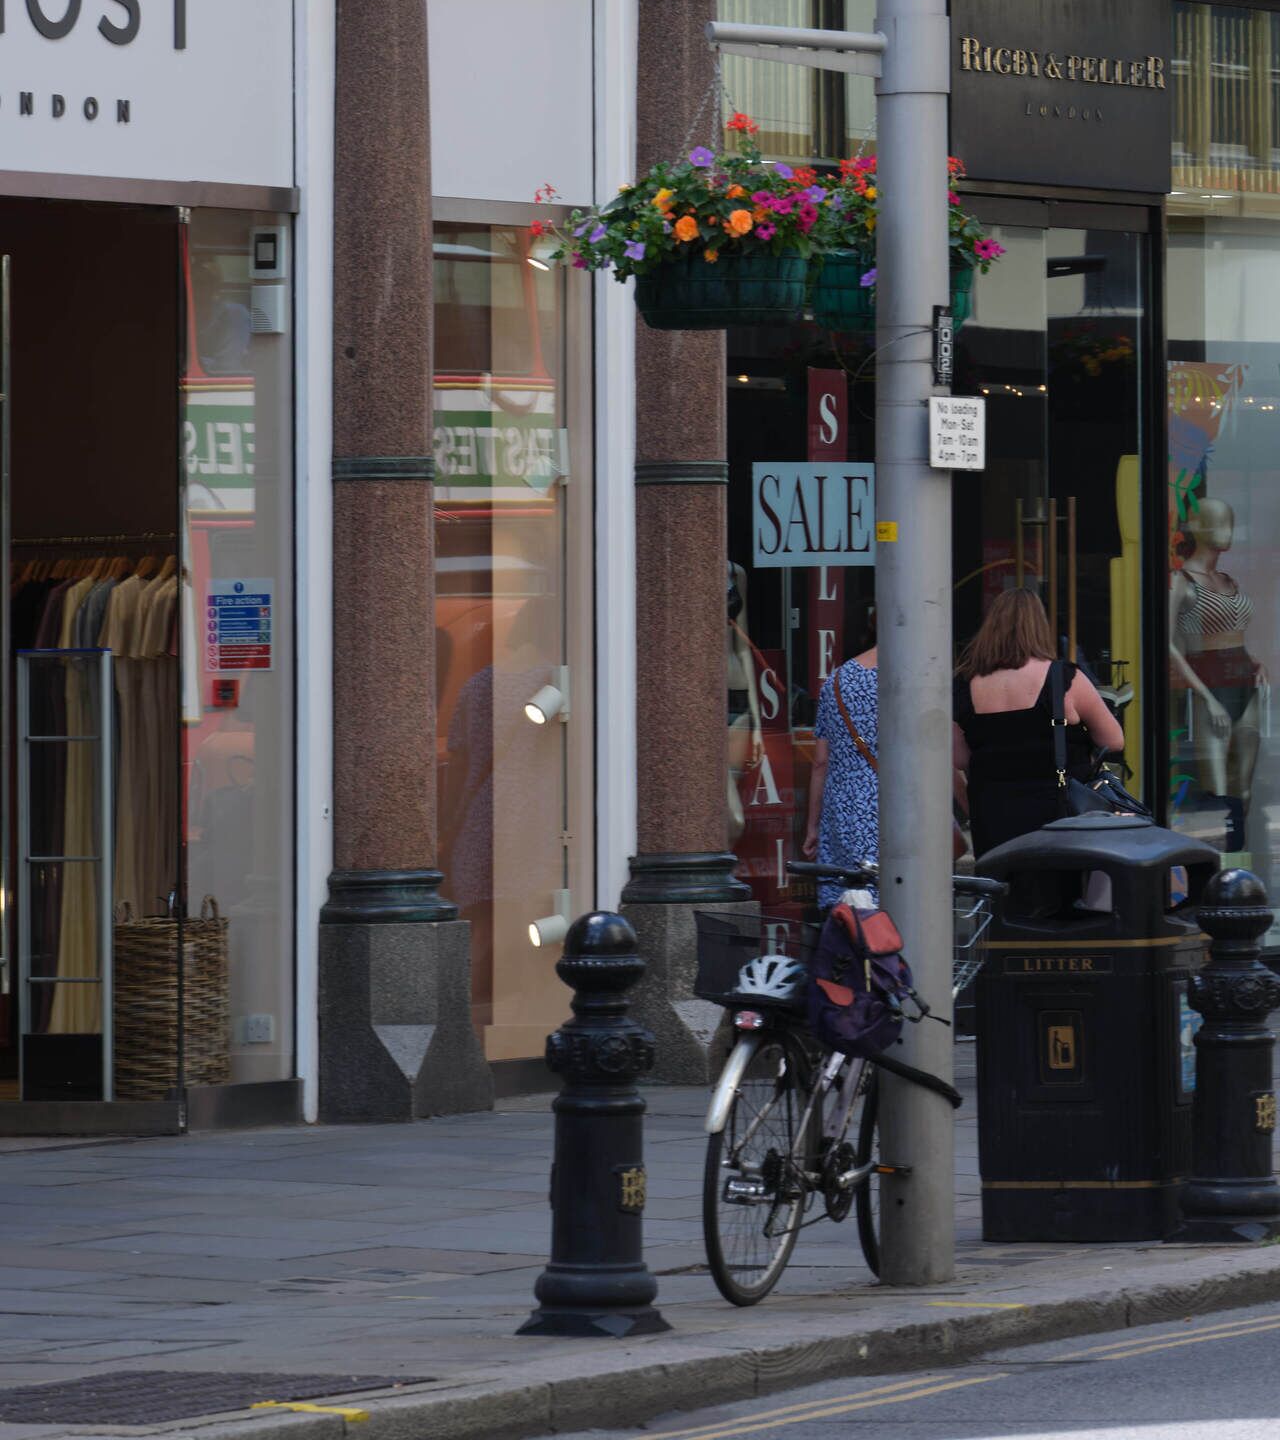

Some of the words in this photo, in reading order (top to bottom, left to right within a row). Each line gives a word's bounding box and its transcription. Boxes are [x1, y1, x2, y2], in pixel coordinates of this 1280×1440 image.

[1044, 54, 1063, 80] &
[0, 91, 131, 124] NDON
[937, 402, 948, 415] No
[951, 403, 978, 418] loading
[758, 474, 870, 555] SALE
[1023, 958, 1094, 971] LITTER
